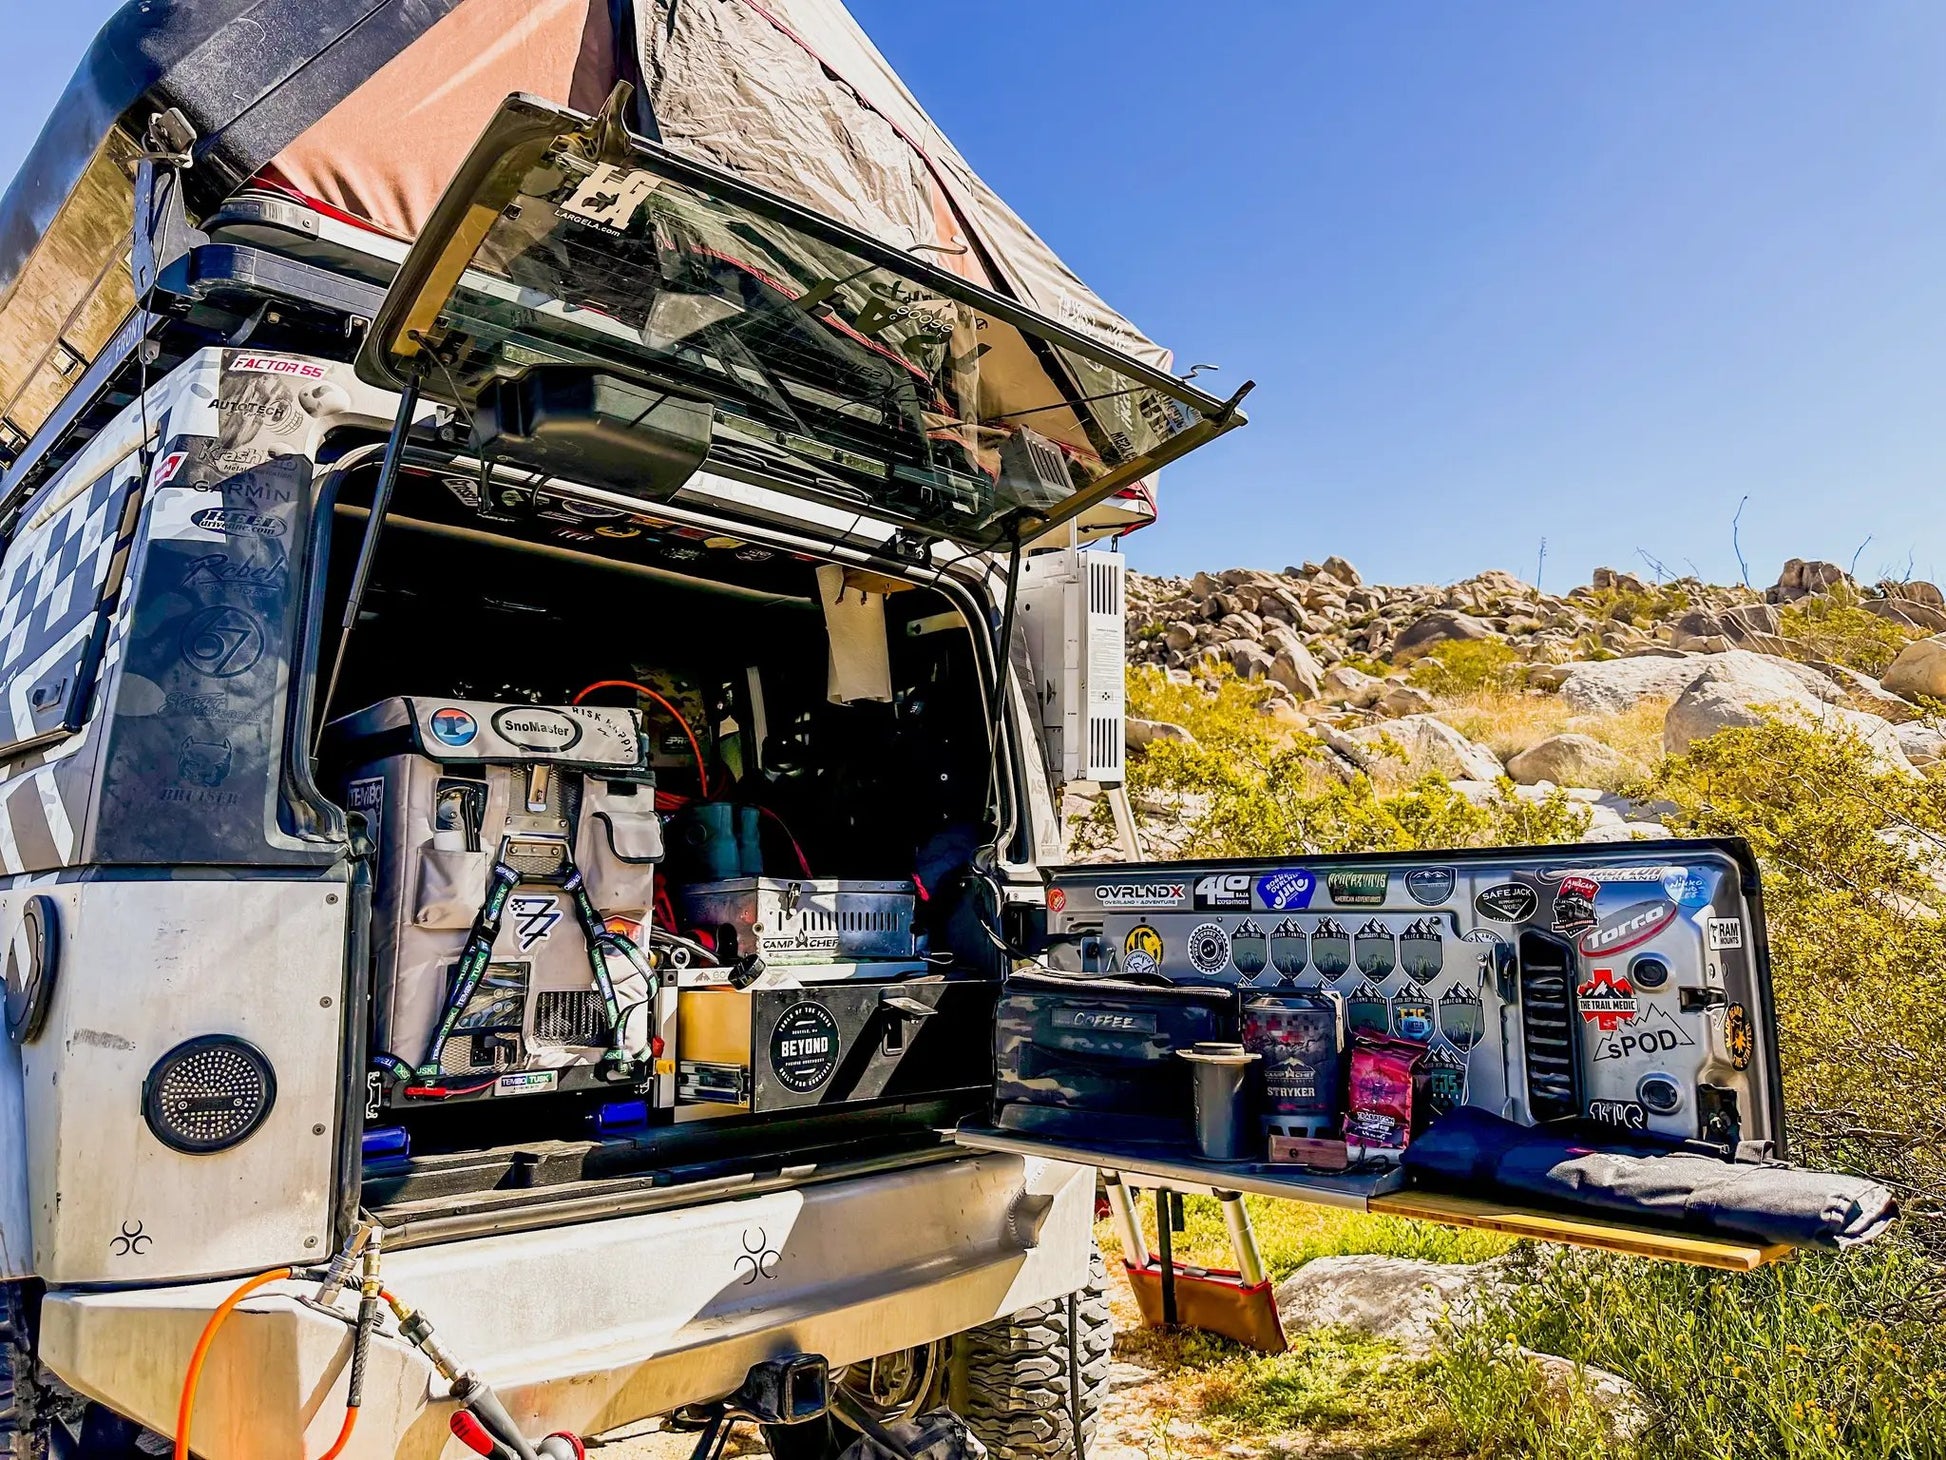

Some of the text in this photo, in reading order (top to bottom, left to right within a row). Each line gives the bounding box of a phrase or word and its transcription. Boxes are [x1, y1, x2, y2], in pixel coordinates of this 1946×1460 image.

[554, 209, 620, 237] LARGELA.com
[234, 358, 324, 378] FACTOR 55
[207, 399, 285, 417] AUTOTECH
[194, 480, 291, 503] GARMIN
[505, 720, 570, 737] SnoMaster
[1096, 886, 1184, 898] OVRLNDX
[1482, 888, 1531, 900] SAFE JACK
[1586, 905, 1665, 949] Torco
[1720, 922, 1739, 936] RAM
[763, 938, 839, 949] CAMP CHEF
[1720, 937, 1739, 945] MOUNTS
[1580, 999, 1636, 1010] THE TRAIL MEDIC
[1074, 1012, 1136, 1028] COFFEE
[781, 1036, 828, 1057] BEYOND
[1609, 1029, 1678, 1059] sPOD
[529, 1075, 550, 1083] TUSK
[1267, 1086, 1316, 1097] STRYKER
